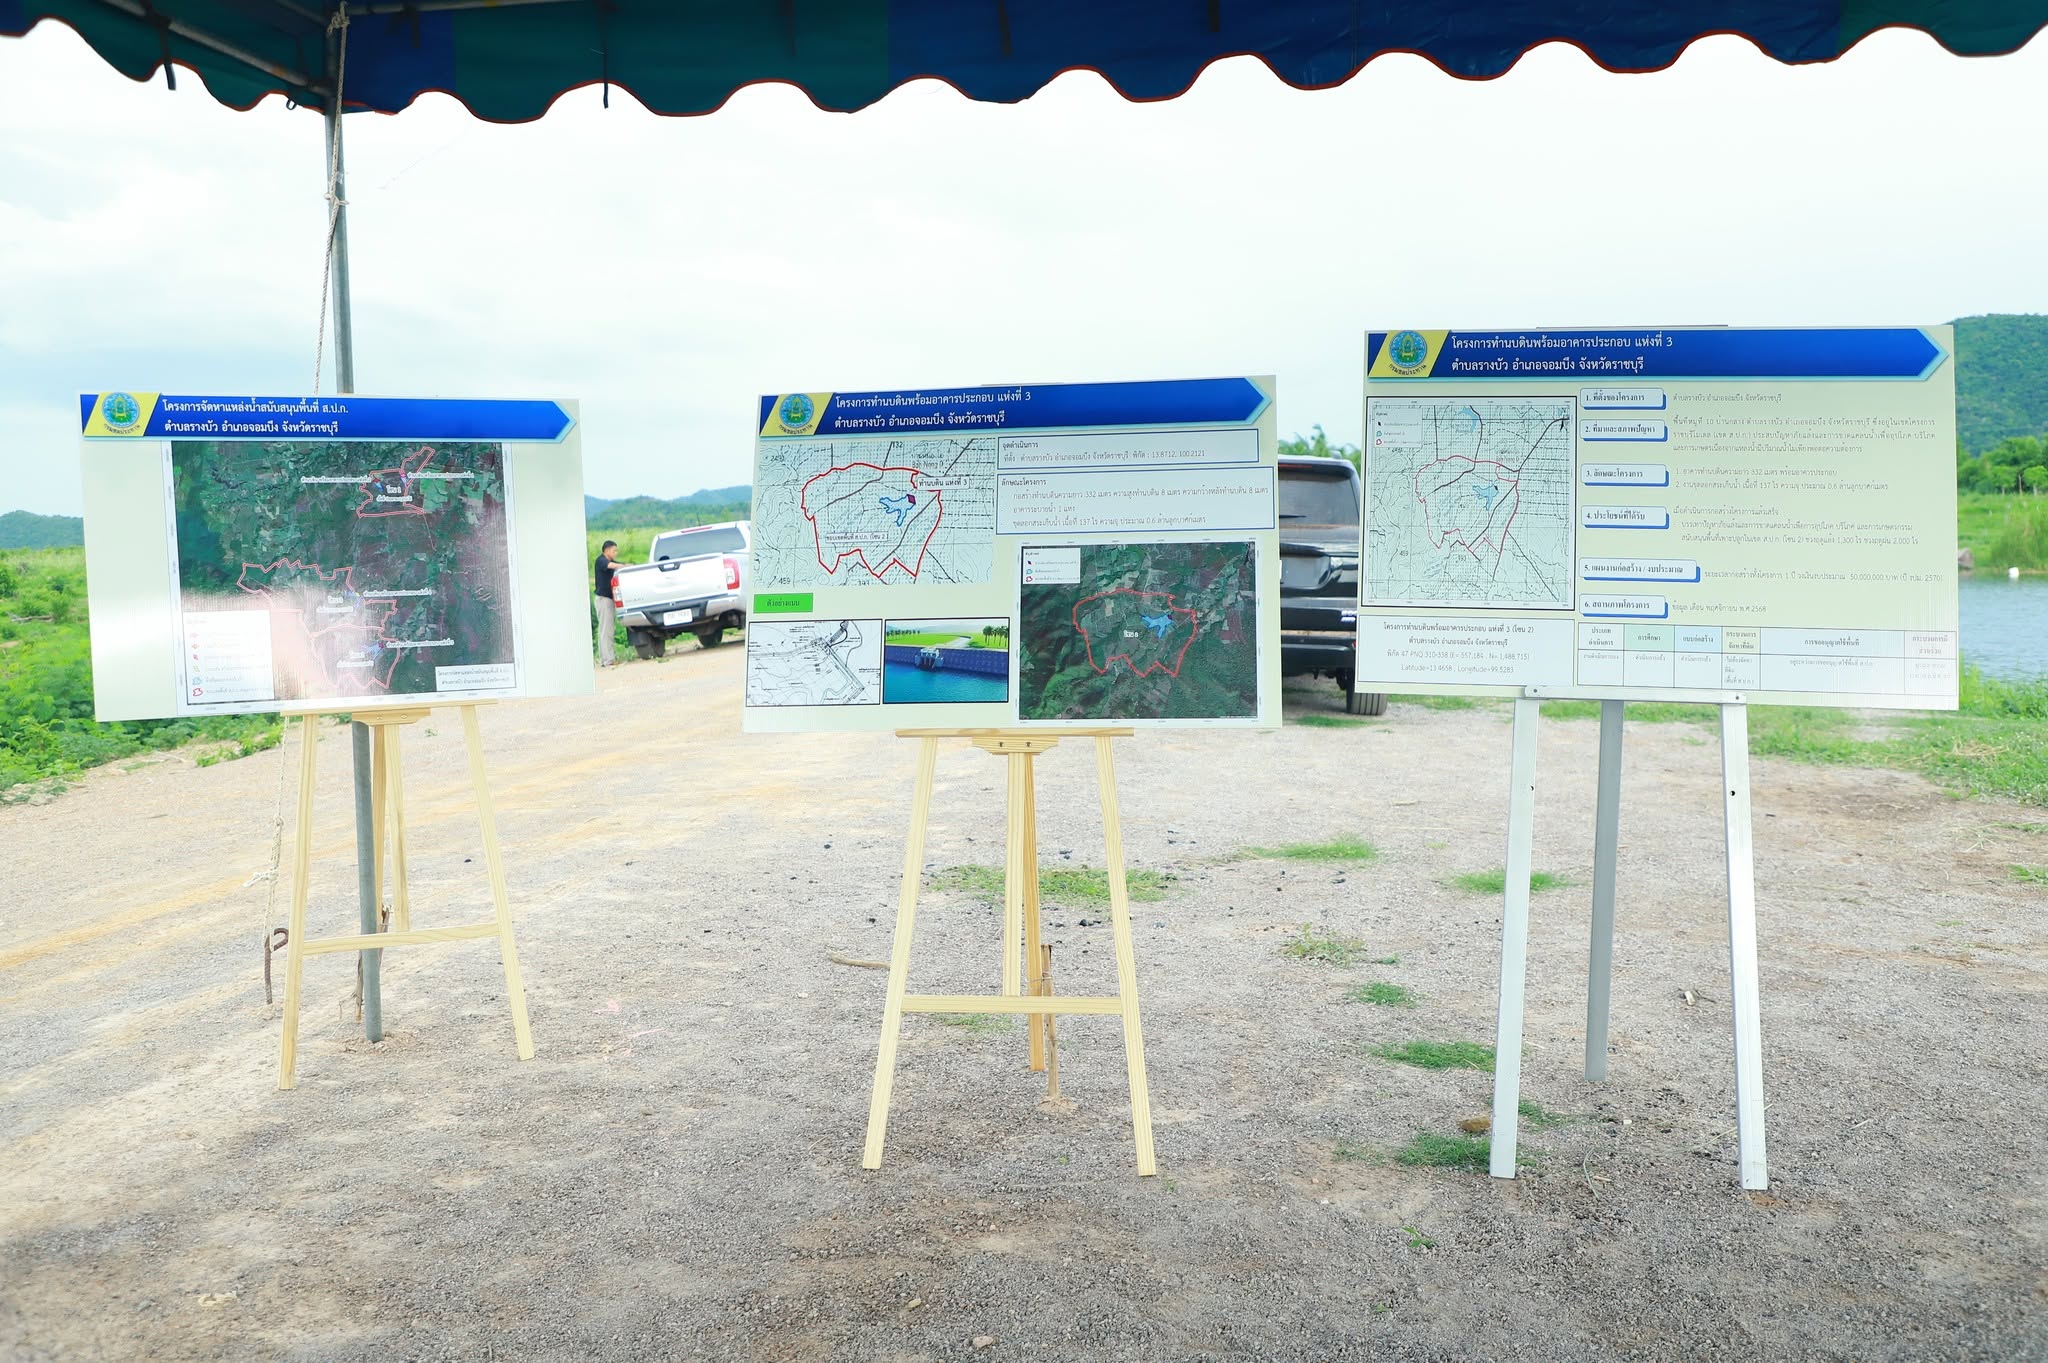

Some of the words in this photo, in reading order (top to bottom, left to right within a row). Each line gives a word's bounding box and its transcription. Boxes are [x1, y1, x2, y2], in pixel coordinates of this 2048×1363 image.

[1452, 334, 1632, 350] โครงการทำนบดินพร้อมอาคารประกอบ
[1634, 331, 1663, 347] แห่งที่
[1666, 336, 1673, 347] 3
[1452, 357, 1509, 371] ตำบลรางบัว
[1512, 356, 1575, 371] อำเภอจอมบึง
[1579, 356, 1644, 373] จังหวัดราชบุรี
[163, 397, 319, 416] โครงการจัดหาแหล่งน้ำสนับสนุนพื้นที่
[322, 402, 348, 413] ส.ป.ก.
[835, 392, 993, 408] โครงการทำนบดินพร้อมอาคารประกอบ
[997, 388, 1022, 401] แห่งที่
[1025, 391, 1031, 401] 3
[164, 420, 219, 432] ตำบลรางบัว
[222, 420, 279, 432] อำเภอจอมบึง
[281, 420, 339, 436] จังหวัดราชบุรี
[835, 413, 885, 428] ตำบลรางบัว
[889, 412, 944, 426] อำเภอจอมบึง
[948, 411, 1005, 426] จังหวัดราชบุรี
[1584, 564, 1590, 572] 5.
